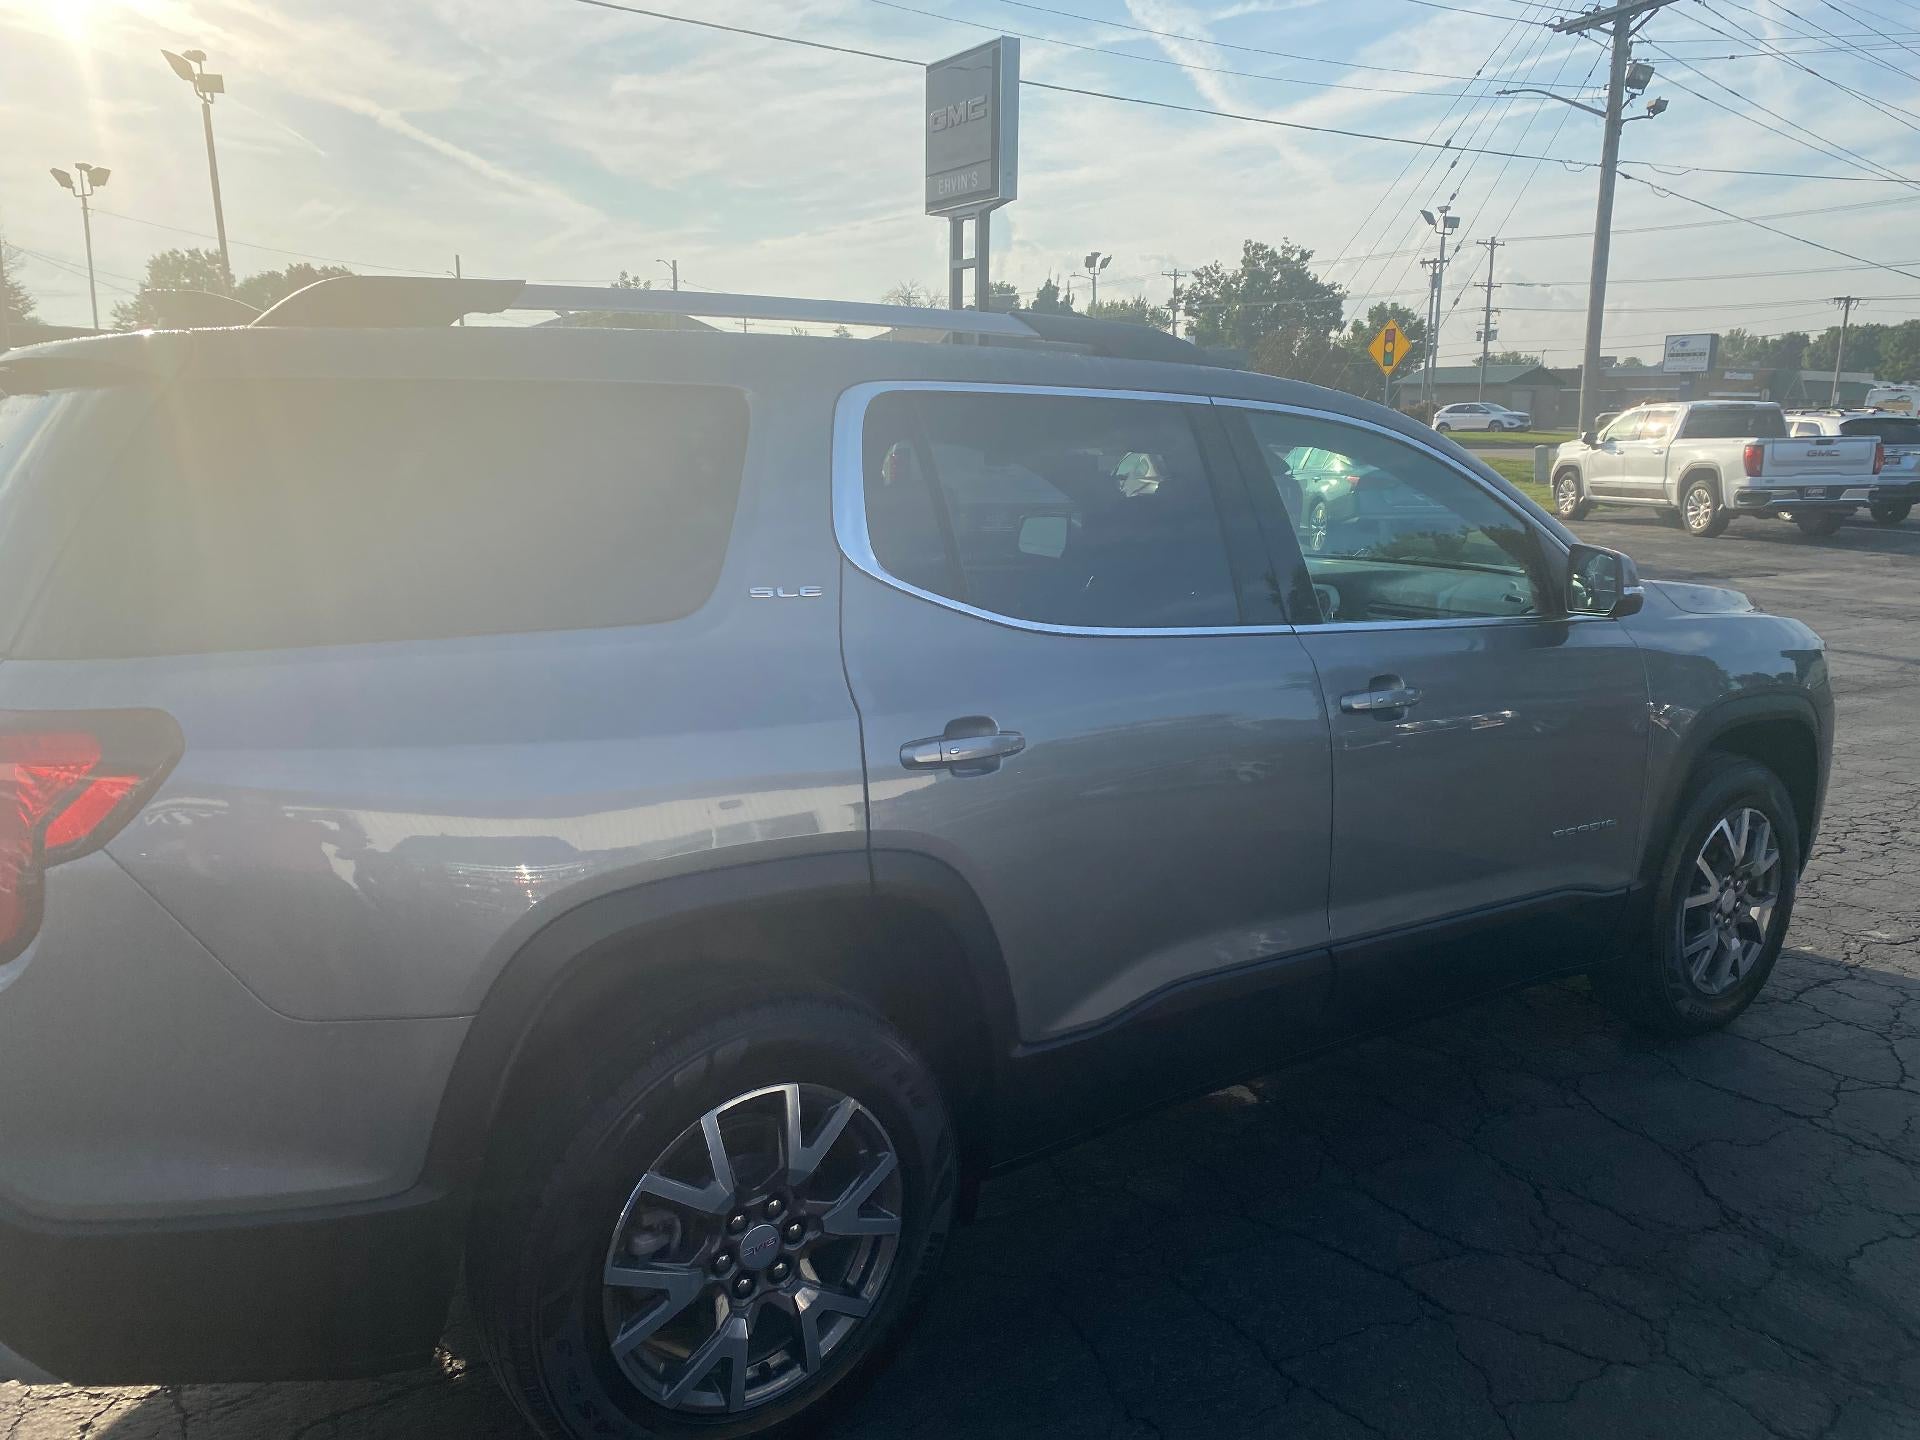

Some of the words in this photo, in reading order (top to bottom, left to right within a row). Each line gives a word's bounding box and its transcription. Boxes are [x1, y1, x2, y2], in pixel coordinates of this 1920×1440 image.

[929, 95, 988, 133] GMC
[938, 171, 979, 194] ERVIN'S
[1807, 449, 1841, 457] GMC
[749, 585, 824, 598] SLE
